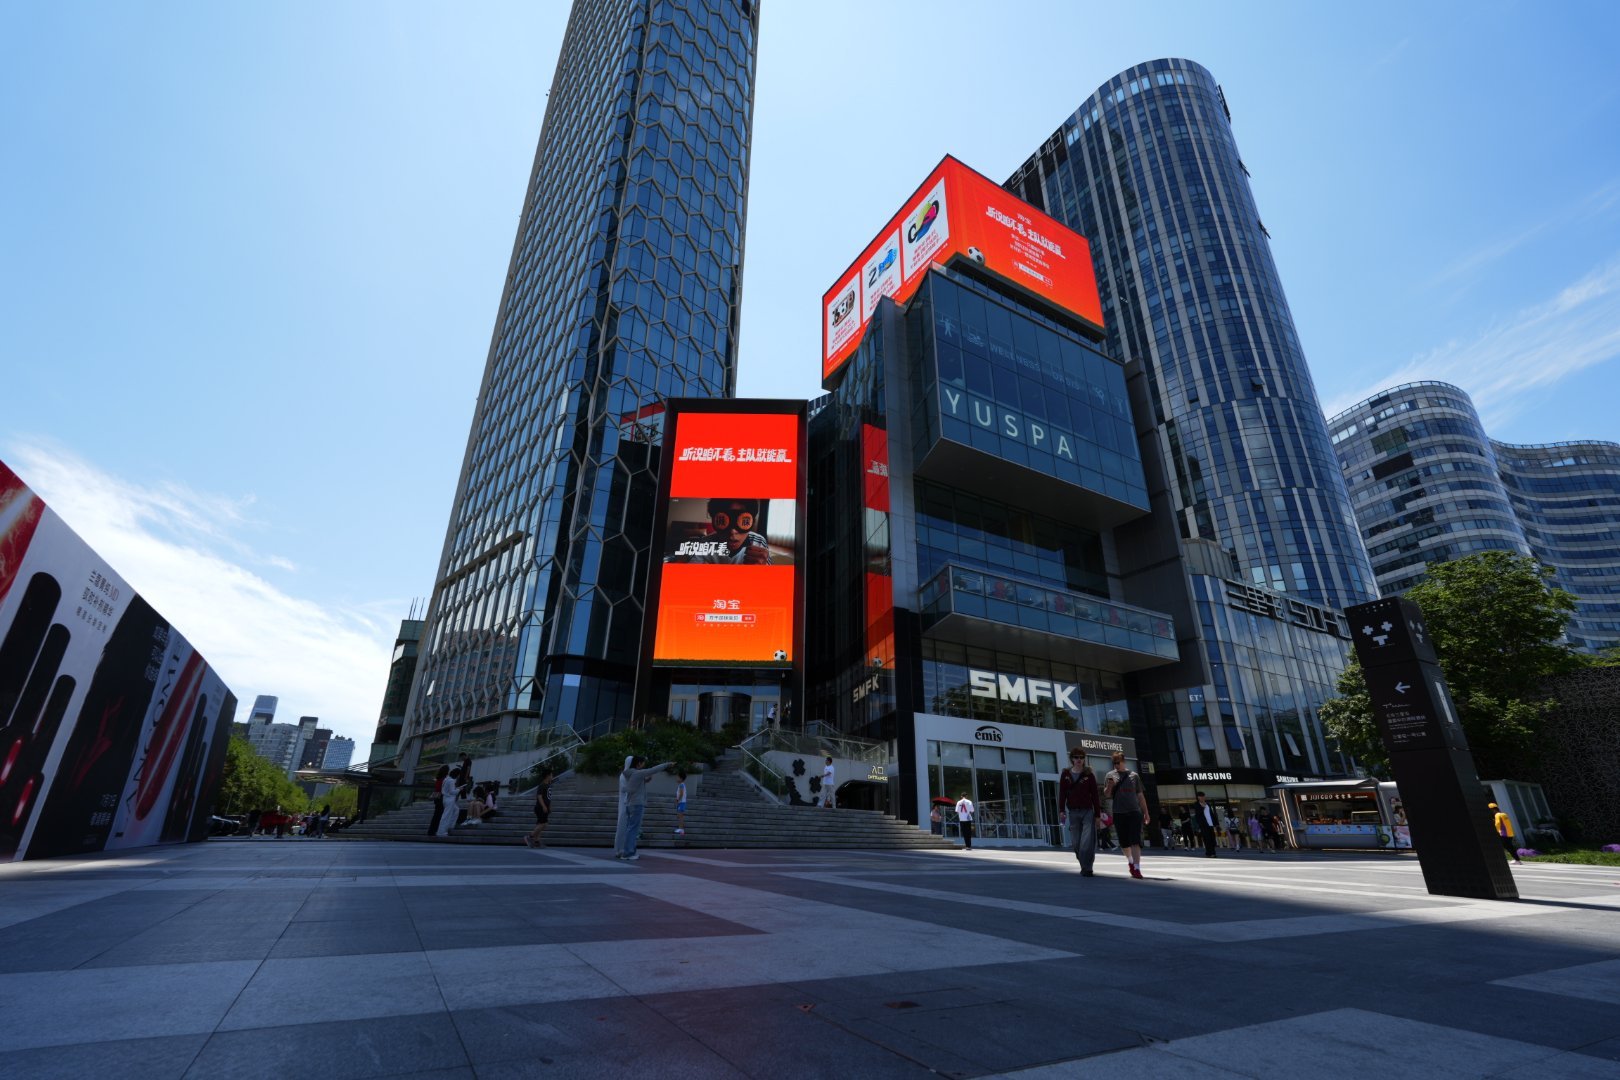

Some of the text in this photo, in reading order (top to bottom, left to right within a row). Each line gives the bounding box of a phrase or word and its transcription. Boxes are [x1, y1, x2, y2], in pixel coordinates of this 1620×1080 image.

[1011, 131, 1062, 189] SOHO
[944, 387, 1074, 460] YUSPA
[712, 599, 741, 610] 淘宝
[1225, 578, 1286, 620] 三里屯
[852, 673, 880, 704] SMFK
[969, 669, 1079, 711] SMFK
[974, 729, 1004, 743] emis
[871, 765, 884, 775] 入口
[1186, 772, 1232, 781] SAMSUNG
